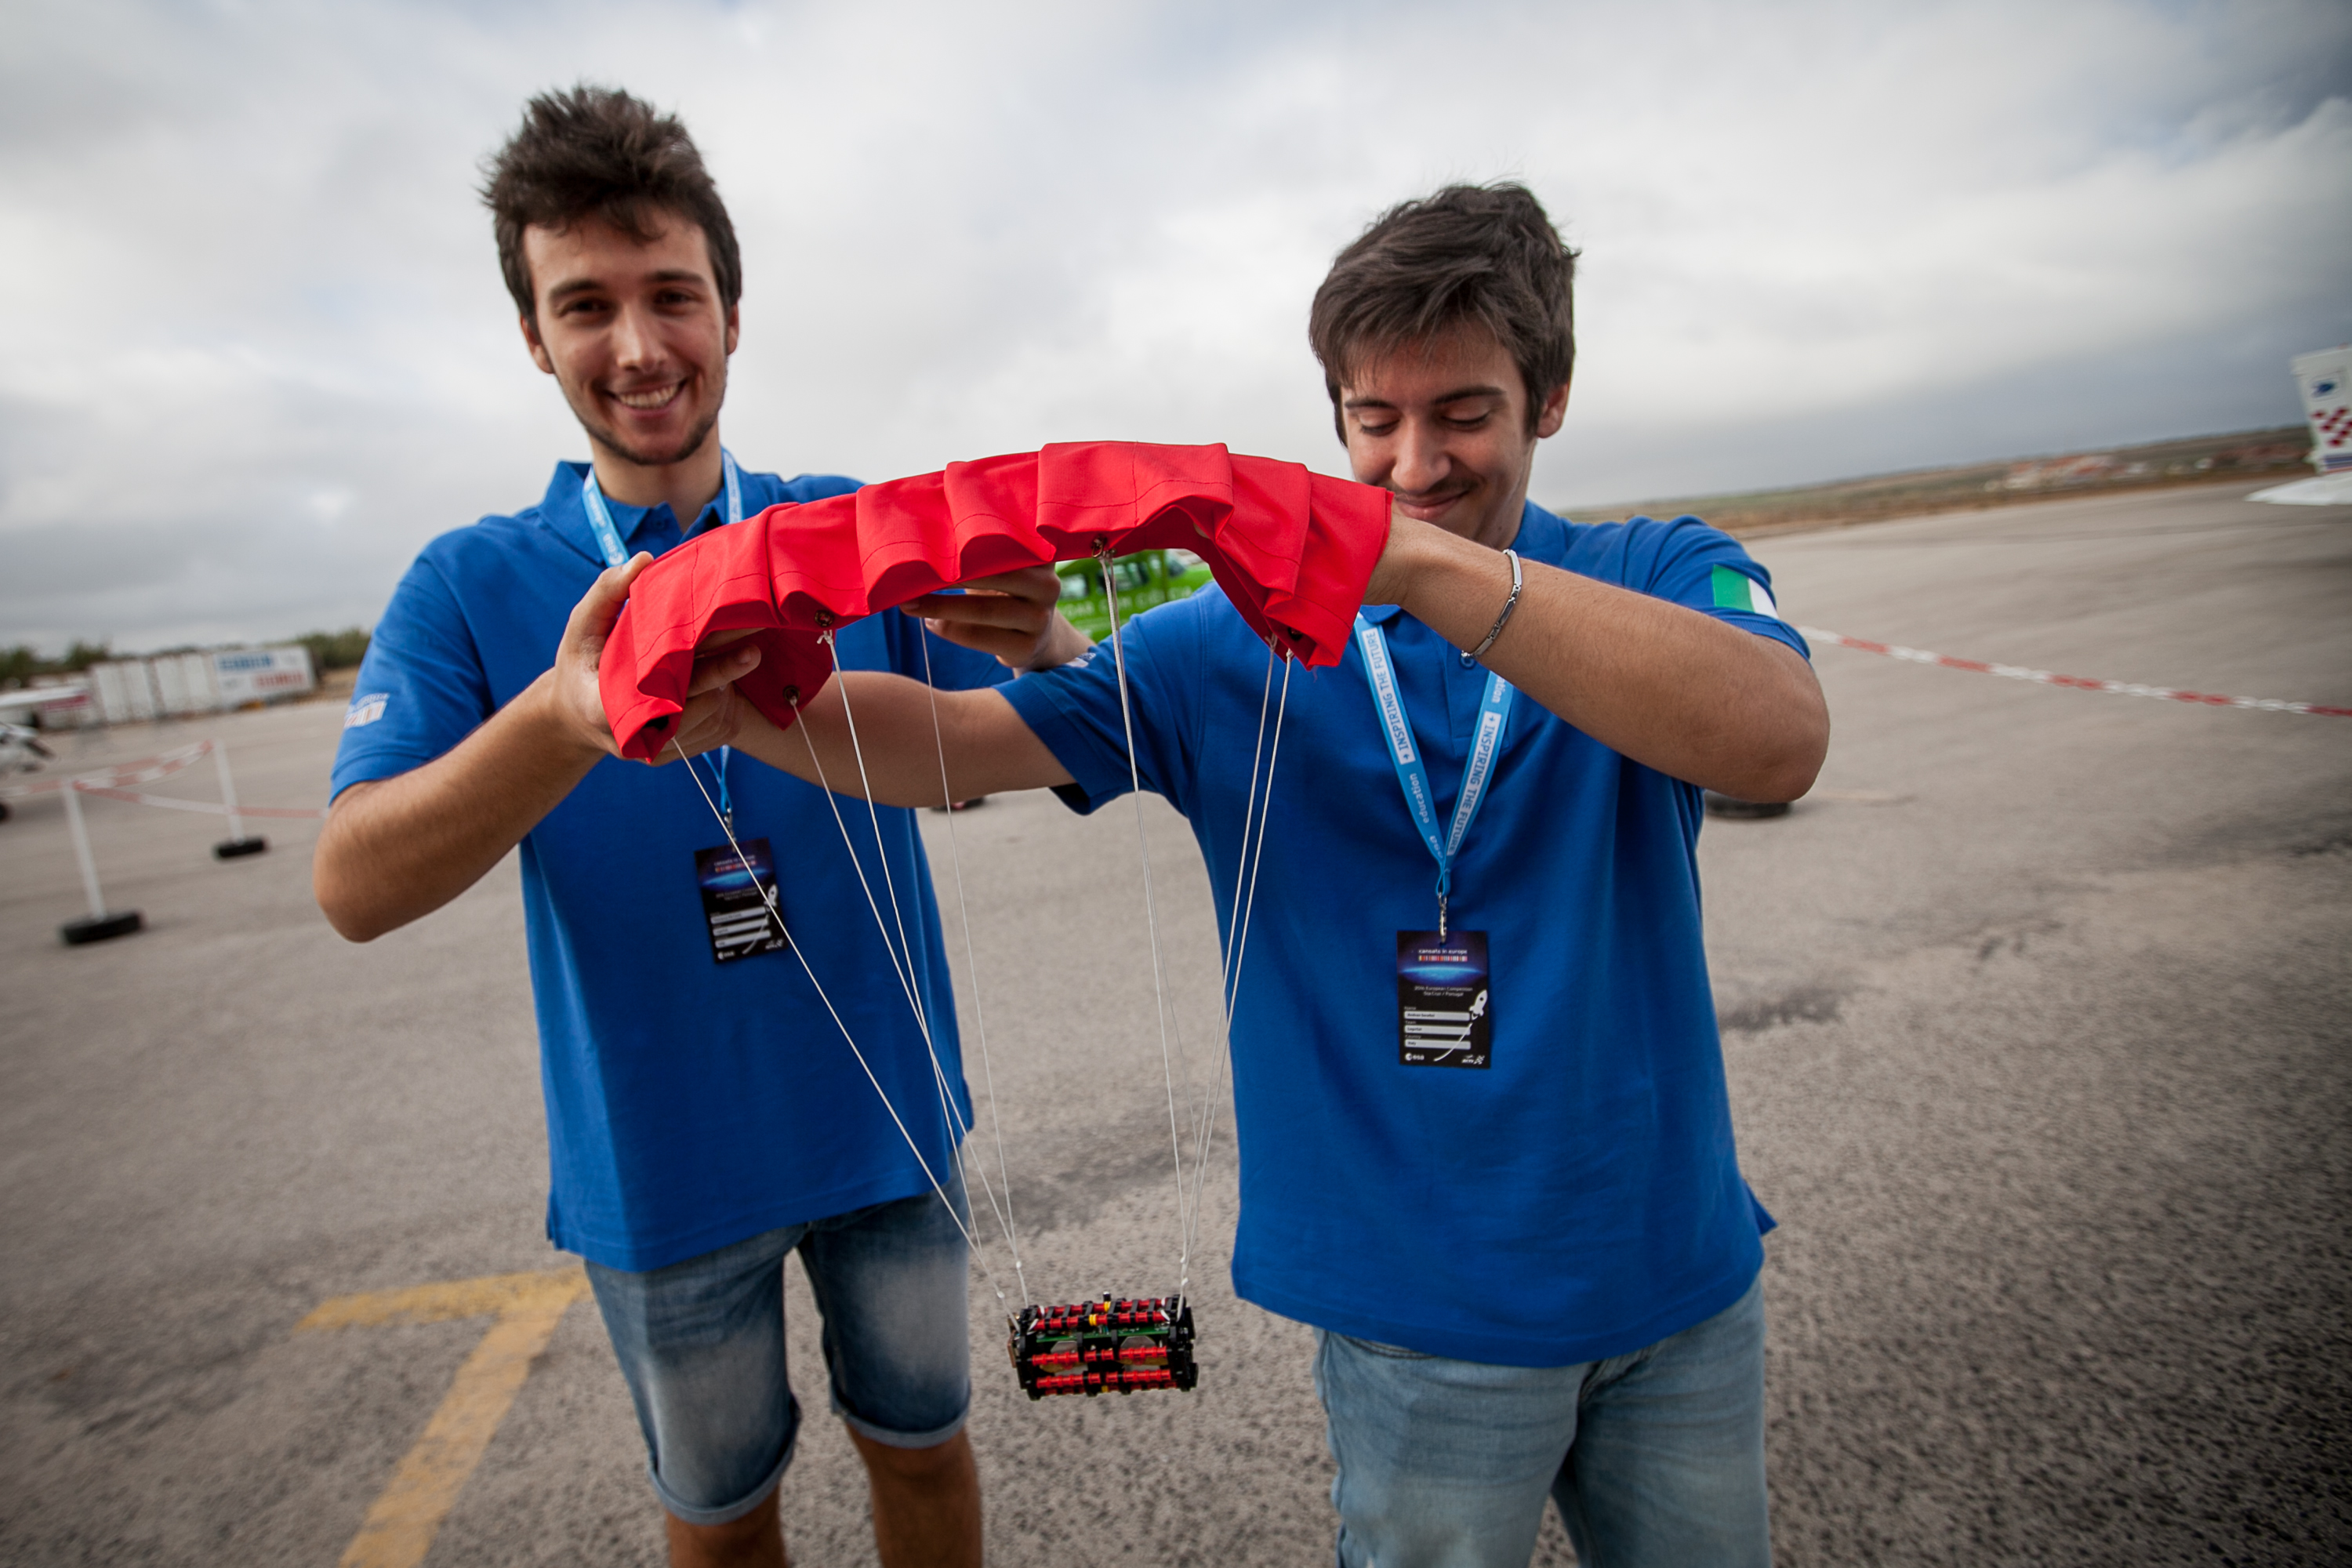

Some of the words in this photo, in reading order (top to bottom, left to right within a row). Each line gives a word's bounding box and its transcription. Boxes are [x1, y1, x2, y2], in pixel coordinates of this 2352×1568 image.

[1366, 631, 1385, 670] FUTURE
[1378, 670, 1391, 691] THE
[1382, 693, 1410, 750] INSPIRING
[1469, 725, 1496, 786] INSPIRING
[1410, 773, 1429, 824] education
[1463, 786, 1479, 809] THE
[1448, 809, 1468, 853] FUTURE
